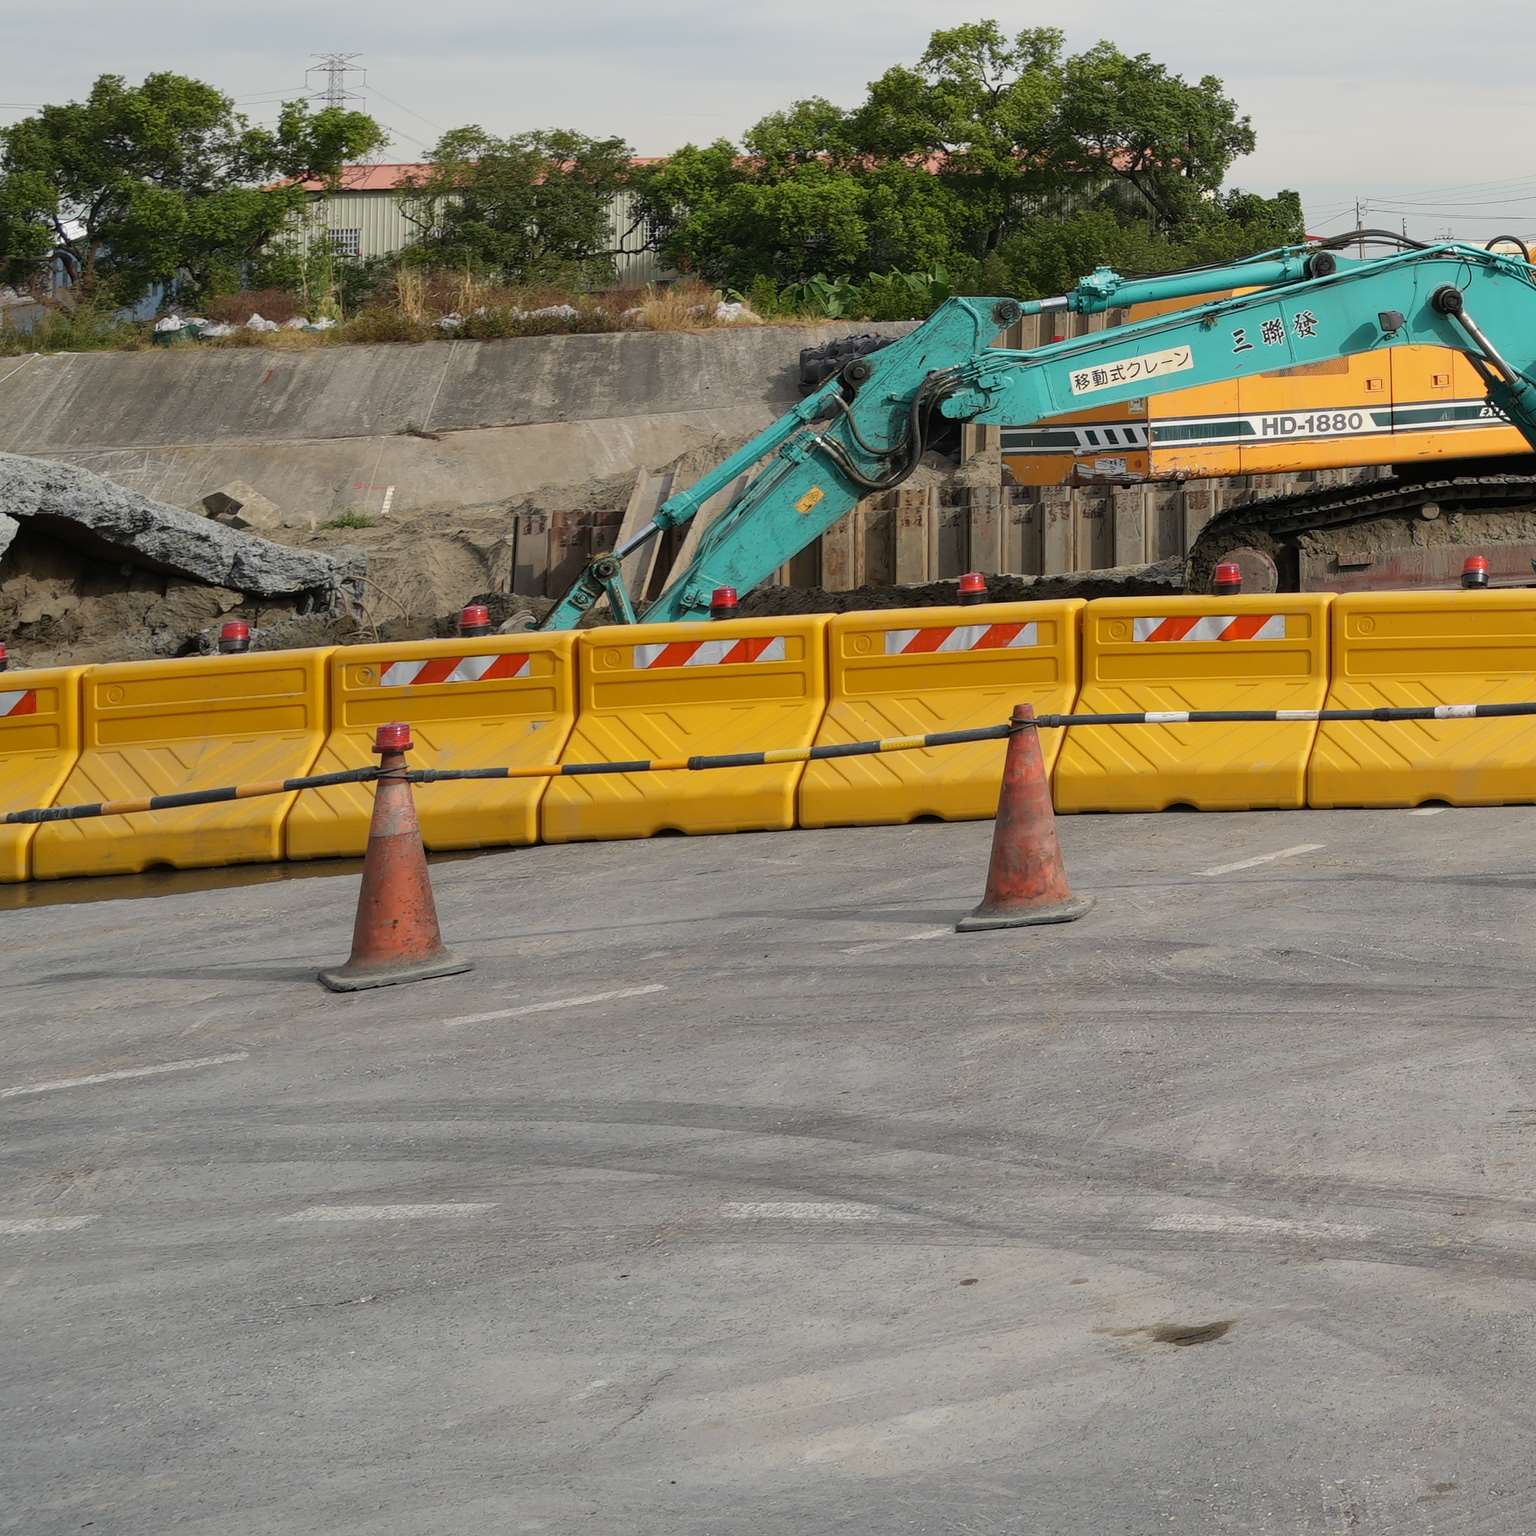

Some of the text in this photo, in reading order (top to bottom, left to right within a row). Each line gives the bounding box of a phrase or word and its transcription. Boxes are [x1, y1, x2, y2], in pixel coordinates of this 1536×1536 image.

[1231, 310, 1318, 354] 三聯發
[1074, 351, 1190, 393] 移動式クレーン
[1261, 412, 1364, 436] HD-1880
